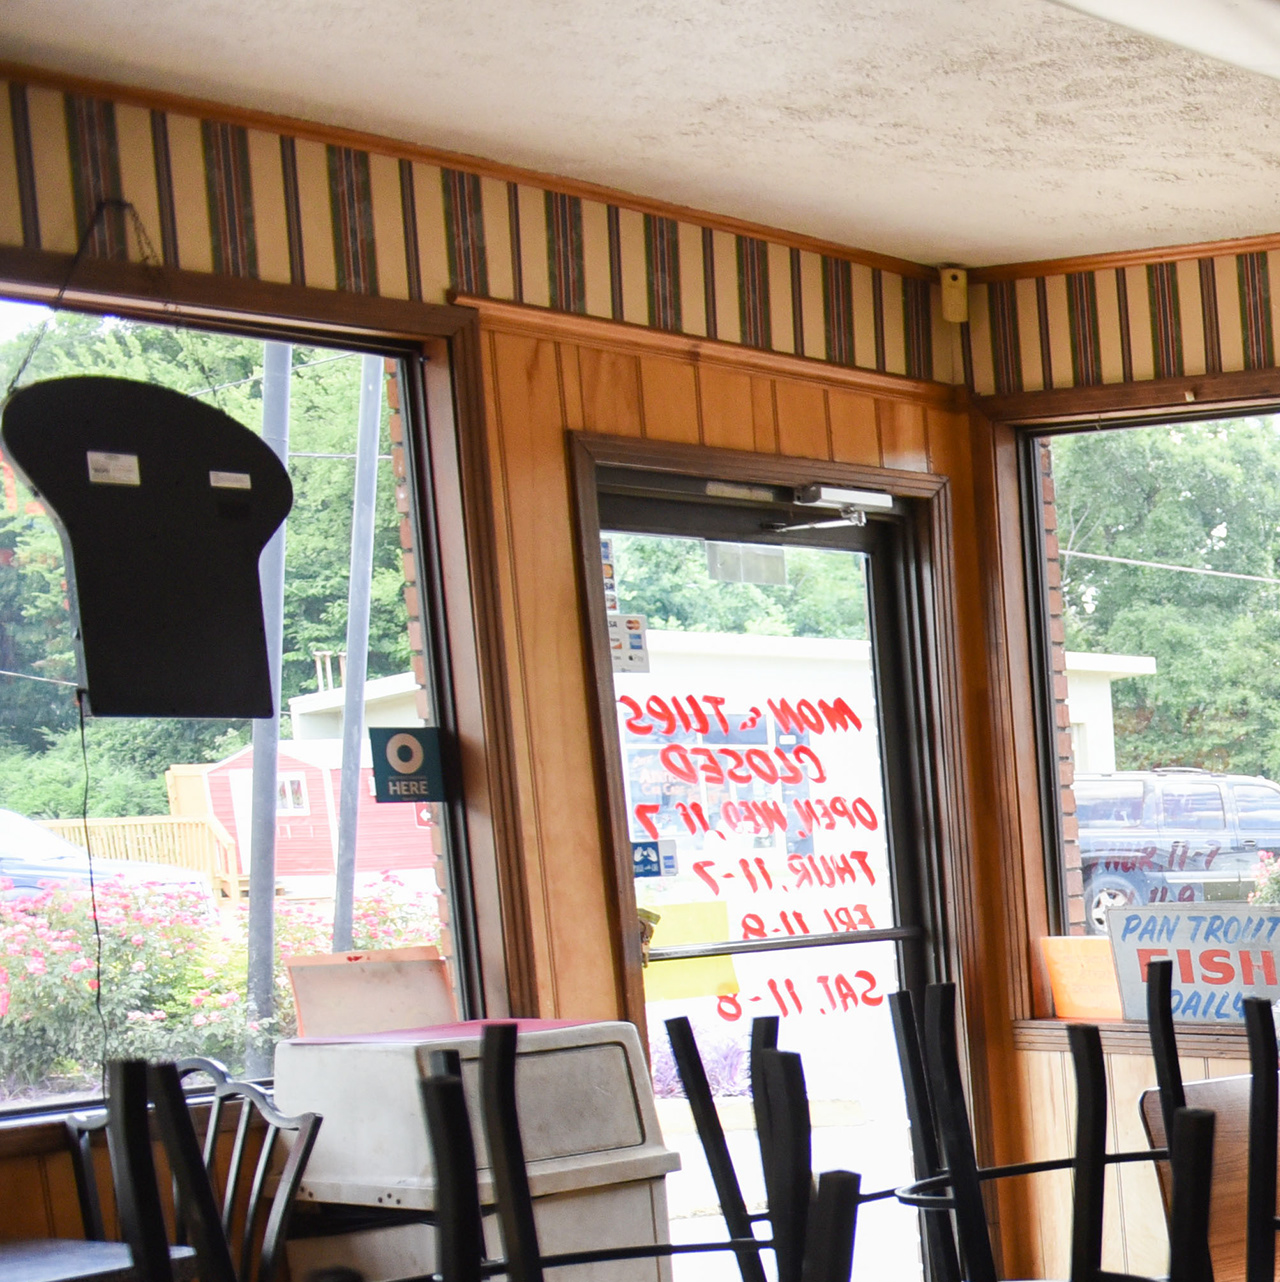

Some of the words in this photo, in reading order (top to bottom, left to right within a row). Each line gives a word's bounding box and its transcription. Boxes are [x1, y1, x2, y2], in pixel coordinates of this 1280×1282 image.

[388, 781, 429, 795] HERE
[1121, 914, 1181, 943] PAN
[1136, 948, 1279, 986] FISH
